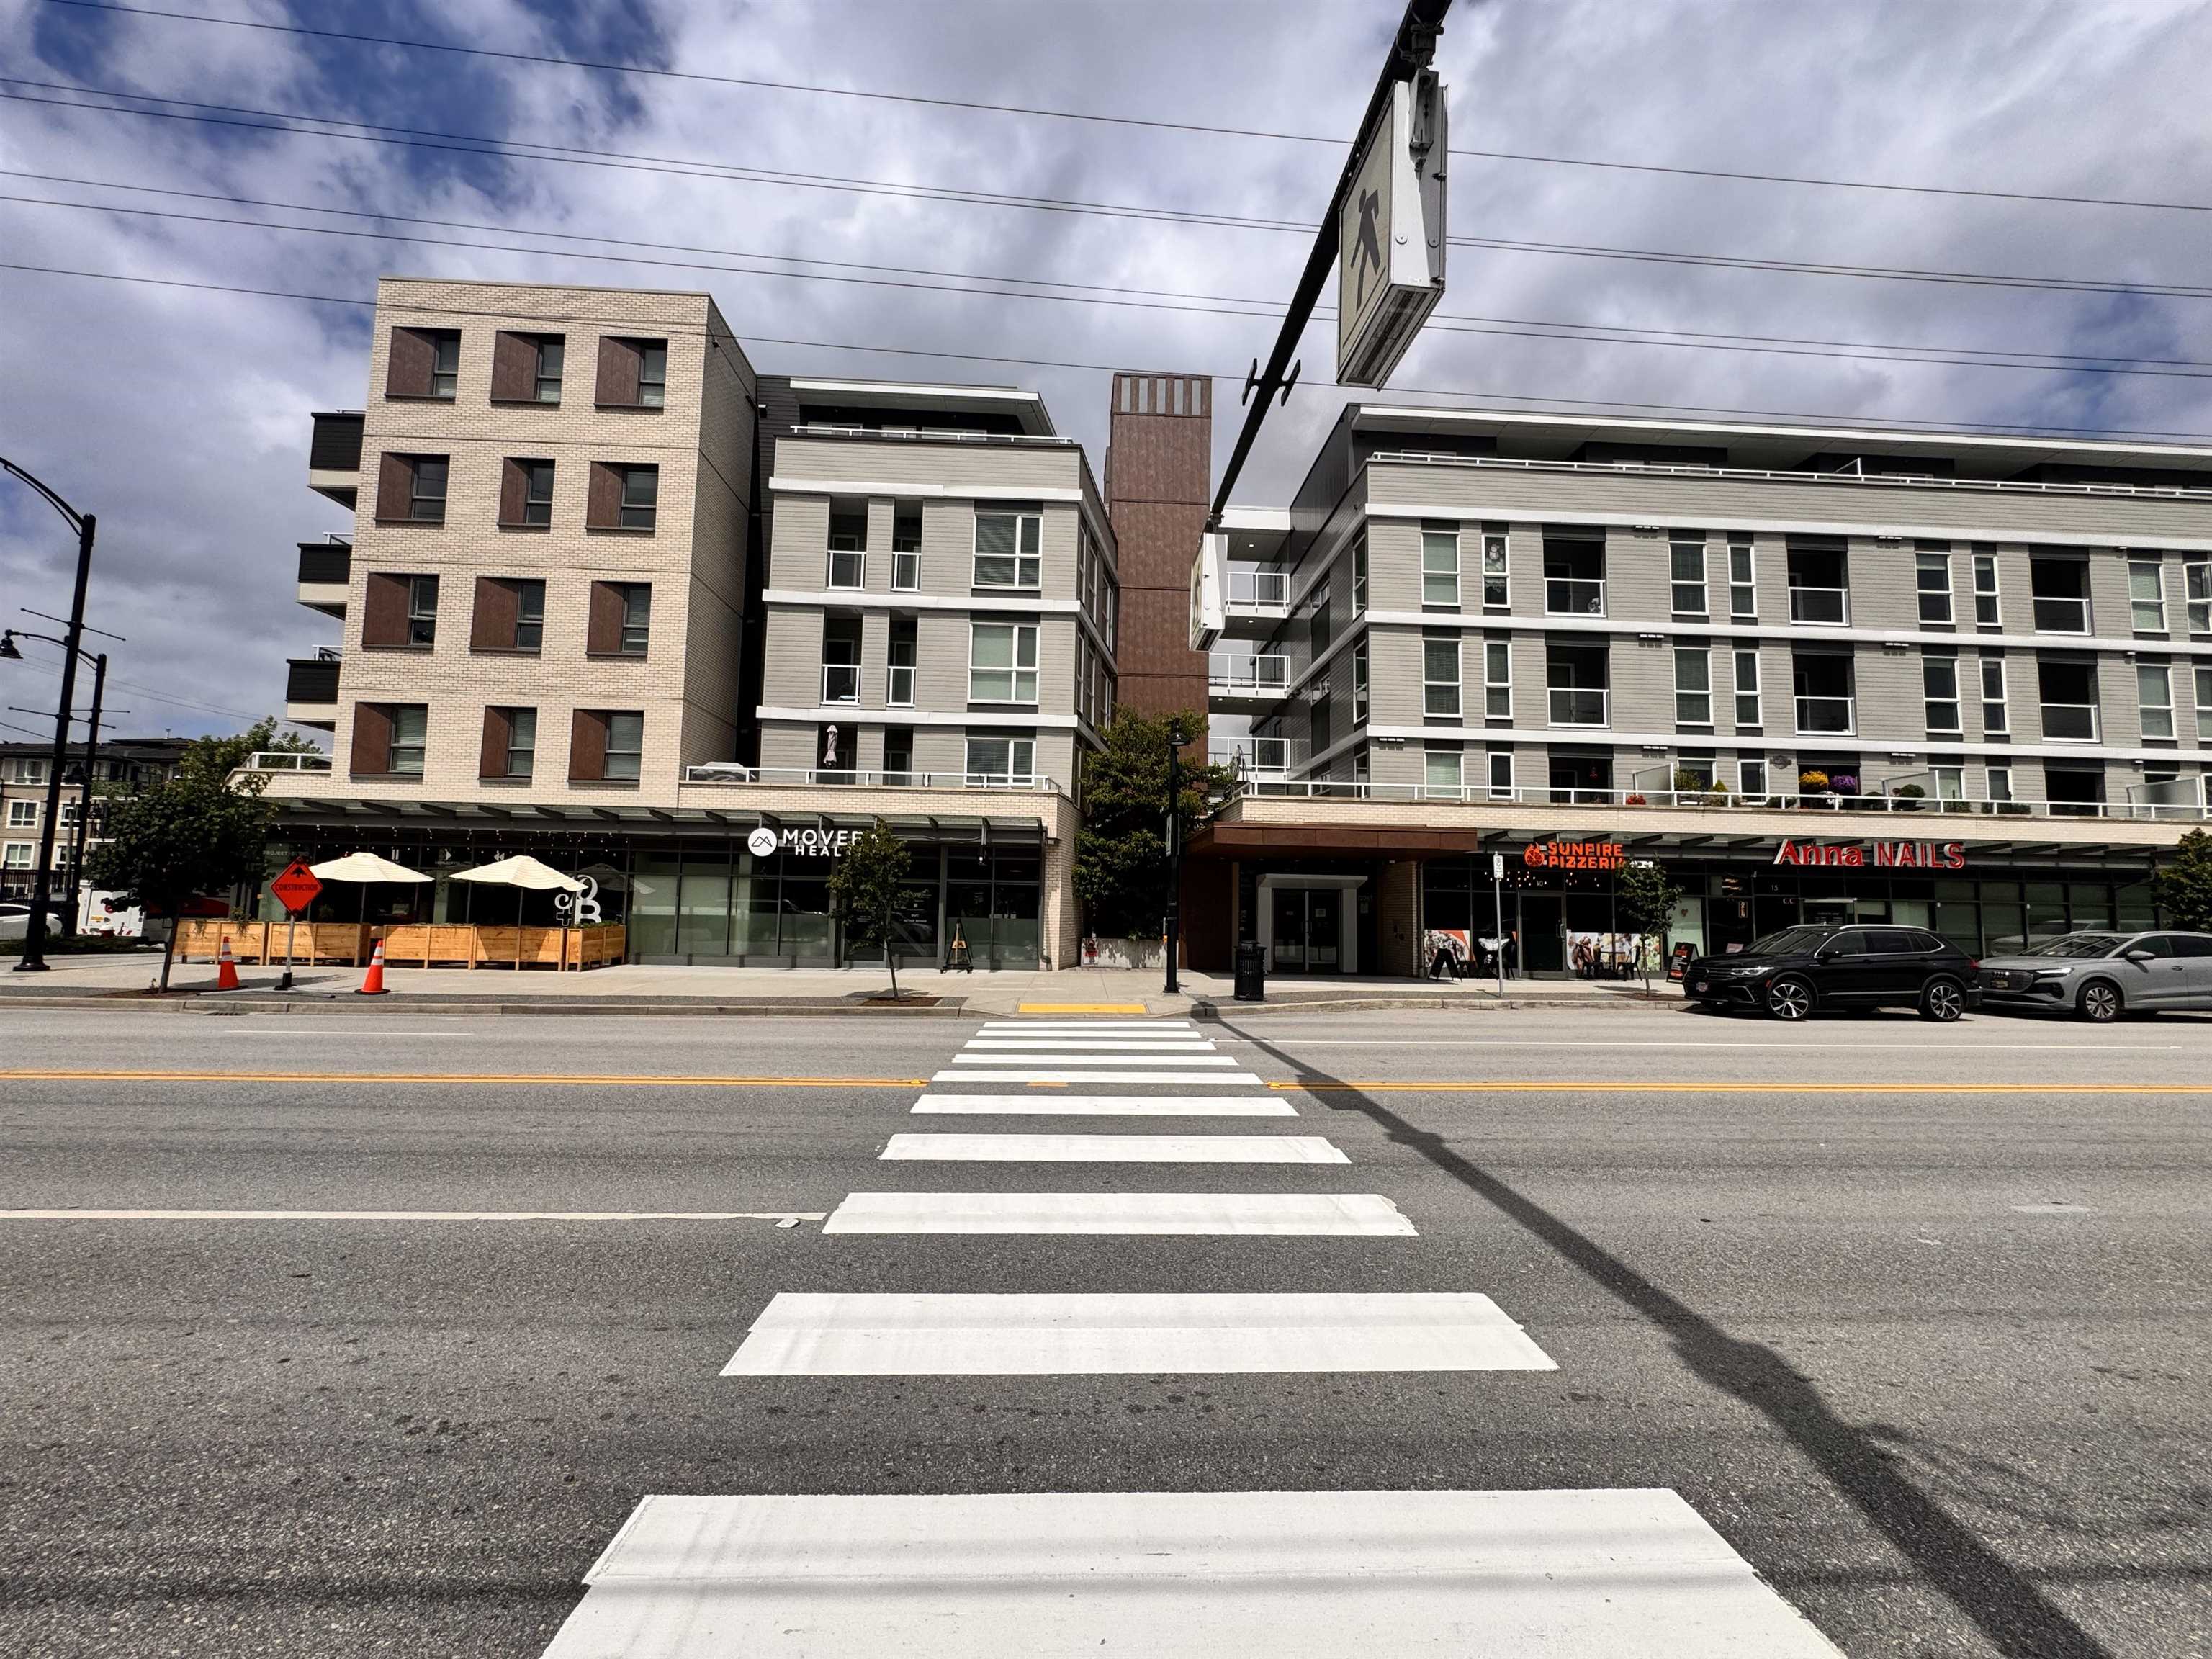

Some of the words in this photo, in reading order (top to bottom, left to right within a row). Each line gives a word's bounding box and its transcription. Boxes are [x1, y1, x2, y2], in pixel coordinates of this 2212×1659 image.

[783, 829, 879, 846] MOVER
[795, 845, 852, 857] HEAL
[1547, 841, 1624, 857] SUNFIRE
[1773, 838, 1864, 866] Anna
[1874, 842, 1965, 869] NAILS
[274, 884, 318, 892] CONSTRUCTION
